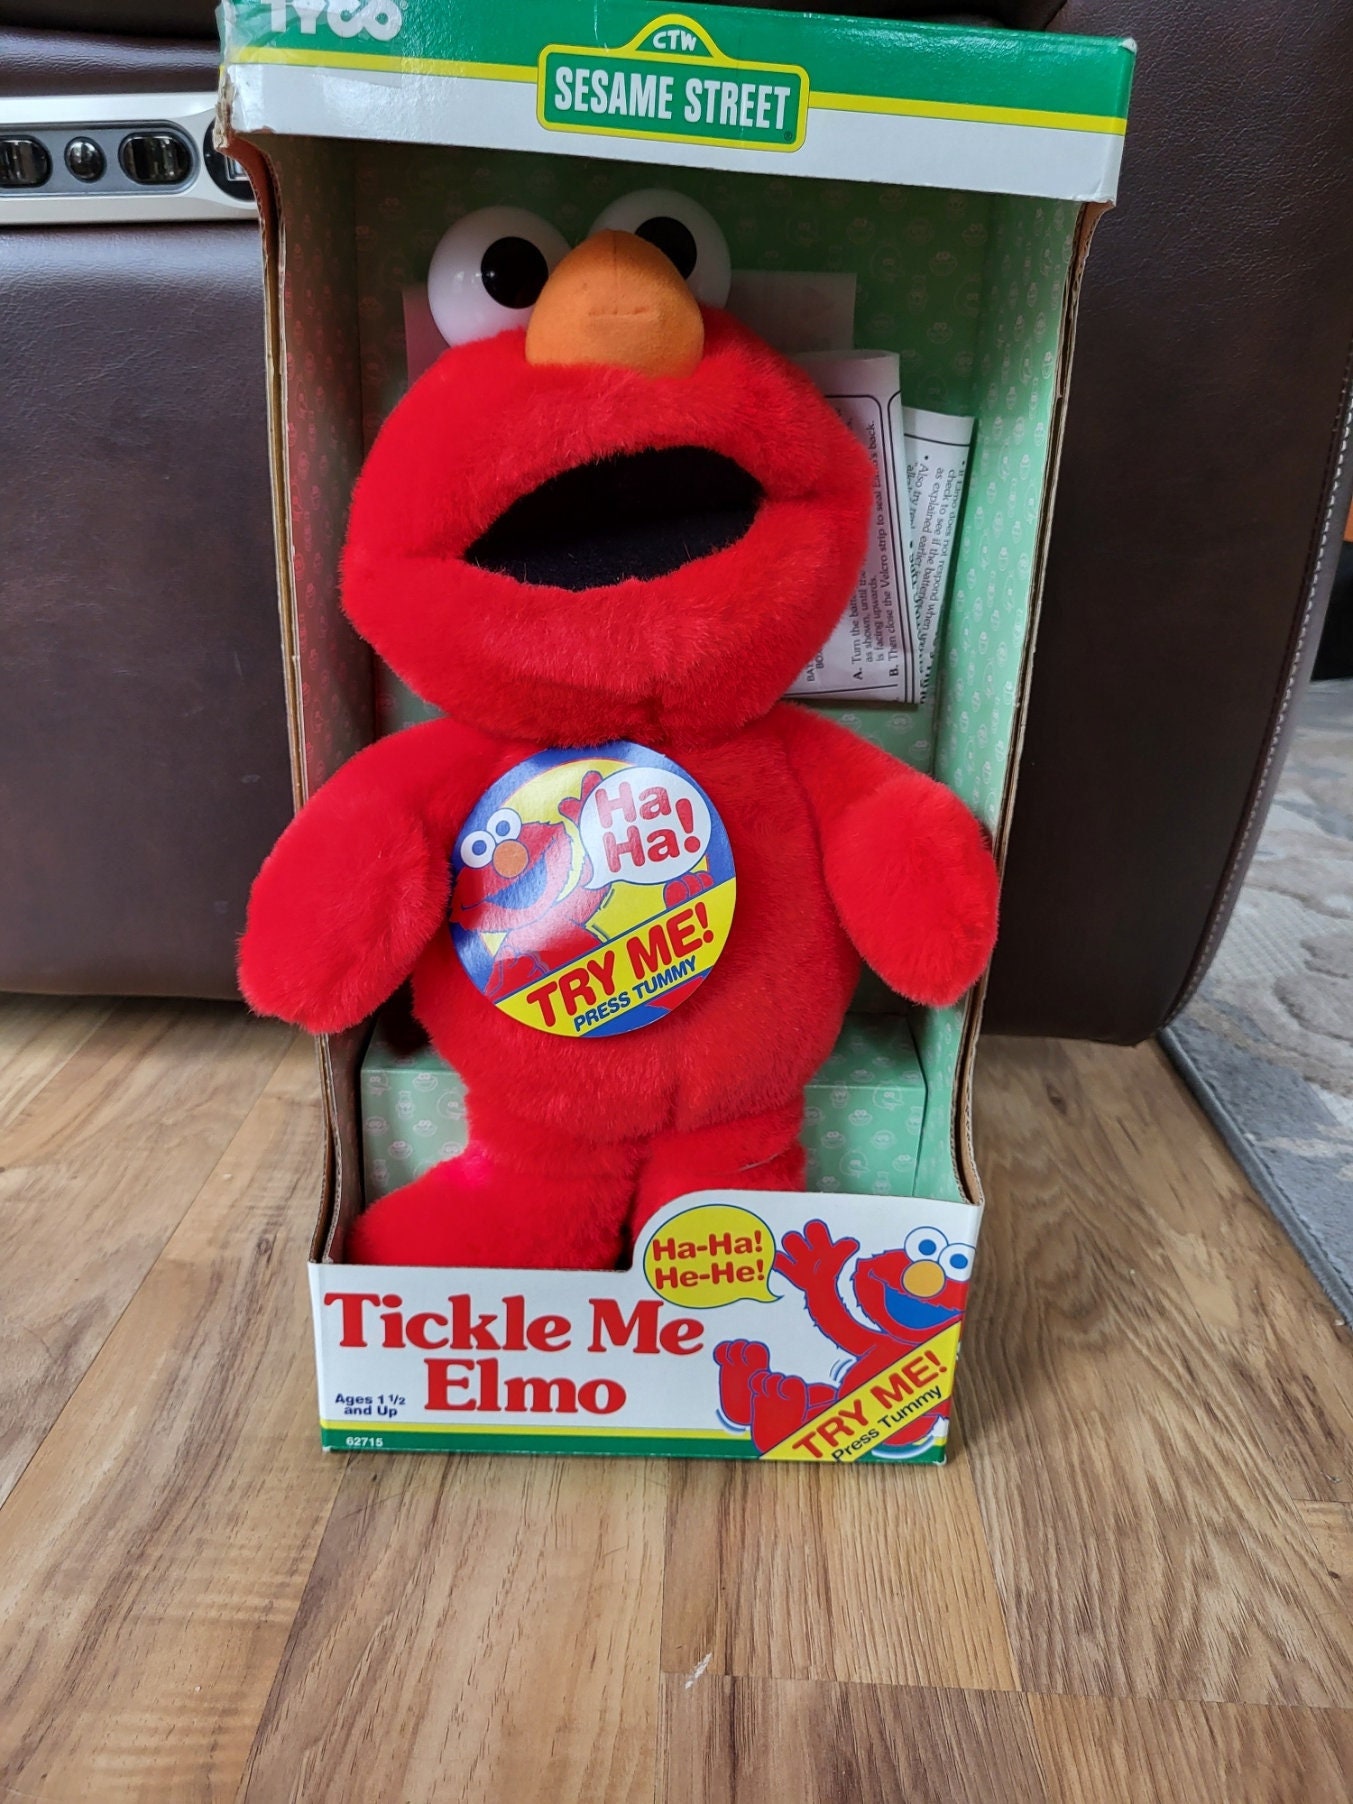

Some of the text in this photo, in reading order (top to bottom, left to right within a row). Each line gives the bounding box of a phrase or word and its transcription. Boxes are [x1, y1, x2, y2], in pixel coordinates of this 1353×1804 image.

[260, 0, 402, 41] TYCO
[653, 30, 697, 51] CTW
[554, 66, 791, 130] SESAME STREET
[866, 421, 877, 450] back.
[915, 463, 929, 488] Also
[935, 467, 944, 479] as
[943, 469, 957, 501] check
[873, 491, 882, 511] seal
[909, 489, 922, 506] try
[922, 482, 941, 533] explained
[939, 504, 948, 515] to
[876, 514, 884, 526] to
[934, 518, 943, 535] see
[945, 511, 956, 536] does
[877, 529, 888, 552] strip
[932, 538, 941, 546] if
[941, 540, 949, 557] not
[926, 548, 939, 566] the
[880, 555, 891, 588] Velcro
[930, 560, 944, 602] respond
[859, 588, 868, 611] until
[881, 591, 892, 607] the
[850, 619, 860, 636] the
[869, 575, 884, 662] is facing upwards.
[885, 609, 895, 634] close
[922, 604, 935, 631] when
[851, 639, 862, 665] Turn
[866, 651, 873, 663] as
[888, 637, 898, 661] Then
[888, 664, 899, 677] B.
[595, 781, 672, 828] Ha
[603, 798, 701, 873] Ha!
[526, 901, 714, 1027] TRY ME!
[573, 955, 697, 1032] PRESS TUMMY
[652, 1229, 763, 1262] Ha-Ha!
[655, 1259, 765, 1290] He-He!
[323, 1292, 705, 1356] Tickle Me
[423, 1357, 627, 1416] Elmo
[335, 1393, 373, 1406] Ages
[344, 1405, 398, 1418] and Up
[792, 1350, 947, 1459] TRY ME!
[831, 1385, 942, 1463] Press Tummy
[345, 1436, 384, 1447] 62715
